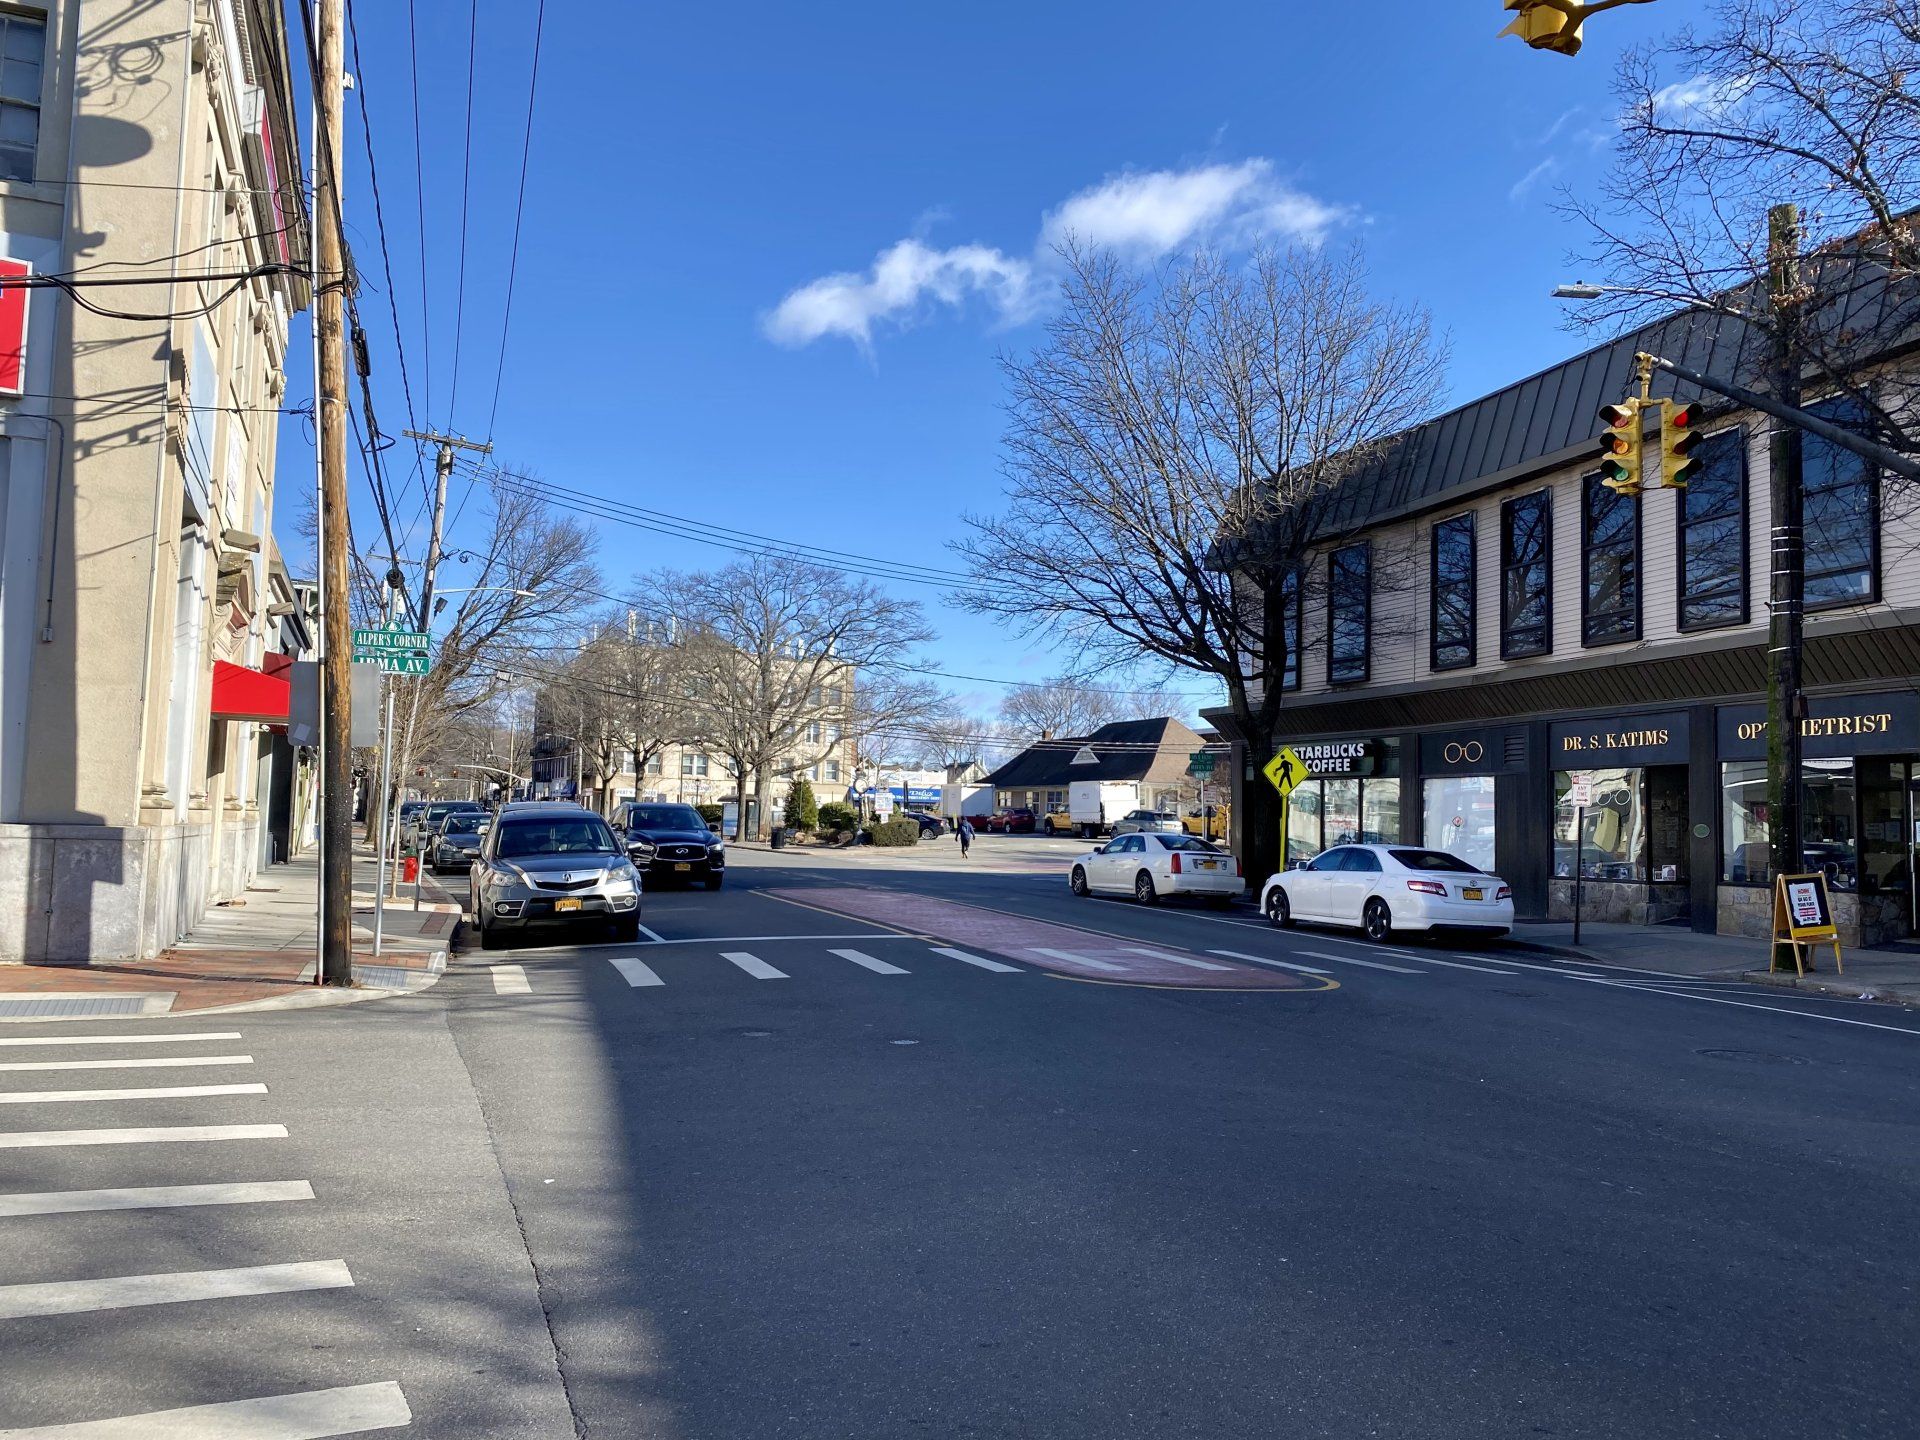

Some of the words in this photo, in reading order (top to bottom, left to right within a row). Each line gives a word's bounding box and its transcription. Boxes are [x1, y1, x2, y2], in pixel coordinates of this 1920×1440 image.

[357, 632, 391, 647] ALPER'S
[394, 634, 428, 648] CORNER
[405, 659, 424, 672] AV.
[1738, 713, 1892, 740] OPETRIST
[1563, 736, 1586, 751] DR.
[1590, 734, 1602, 749] S.
[1606, 729, 1669, 748] KATIMS
[1292, 742, 1365, 760] STARBUCKS
[1305, 758, 1351, 773] COFFEE
